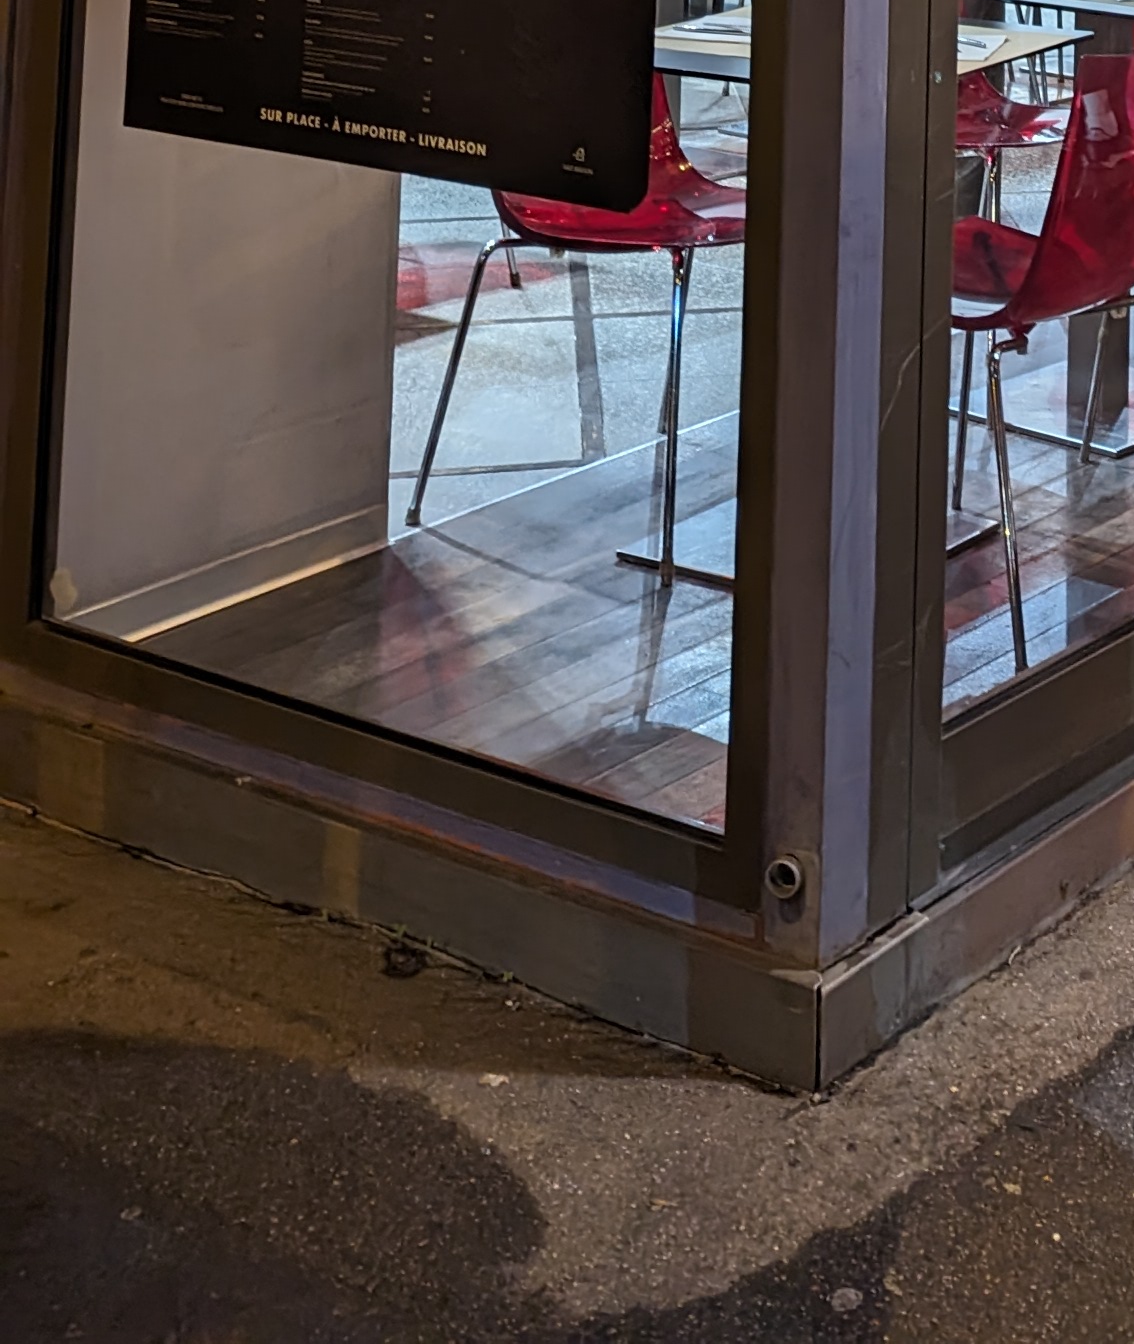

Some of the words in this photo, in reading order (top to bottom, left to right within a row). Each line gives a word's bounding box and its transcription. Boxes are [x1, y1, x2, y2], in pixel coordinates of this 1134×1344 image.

[260, 107, 282, 123] SUR
[286, 112, 321, 130] PLACE
[332, 115, 341, 132] À
[345, 120, 406, 144] EMPORTER
[418, 133, 487, 157] LIVRAISON
